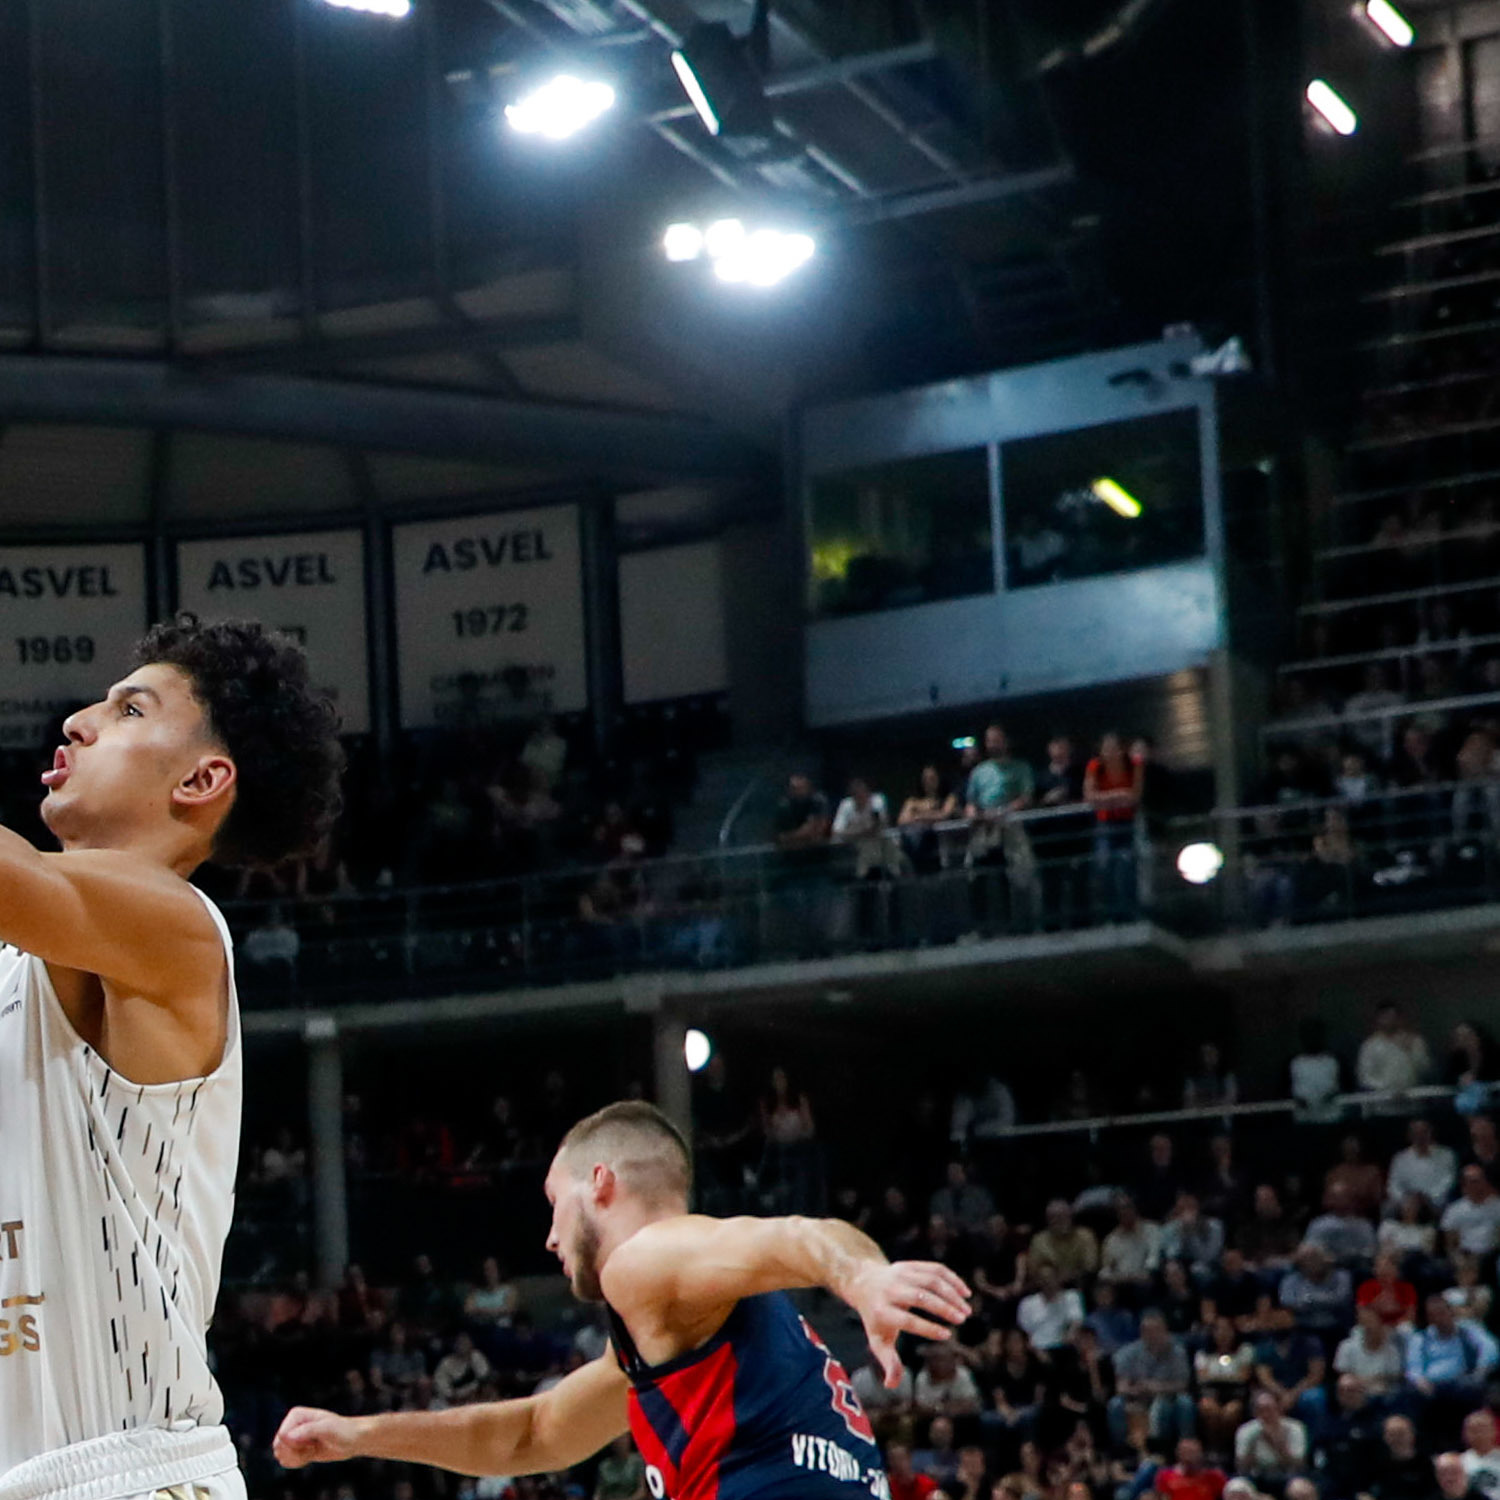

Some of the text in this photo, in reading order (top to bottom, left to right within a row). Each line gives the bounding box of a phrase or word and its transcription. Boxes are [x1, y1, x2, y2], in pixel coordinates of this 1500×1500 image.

[423, 529, 553, 575] ASVEL
[207, 553, 337, 592] ASVEL
[452, 602, 528, 638] 1972
[15, 634, 96, 665] 1969
